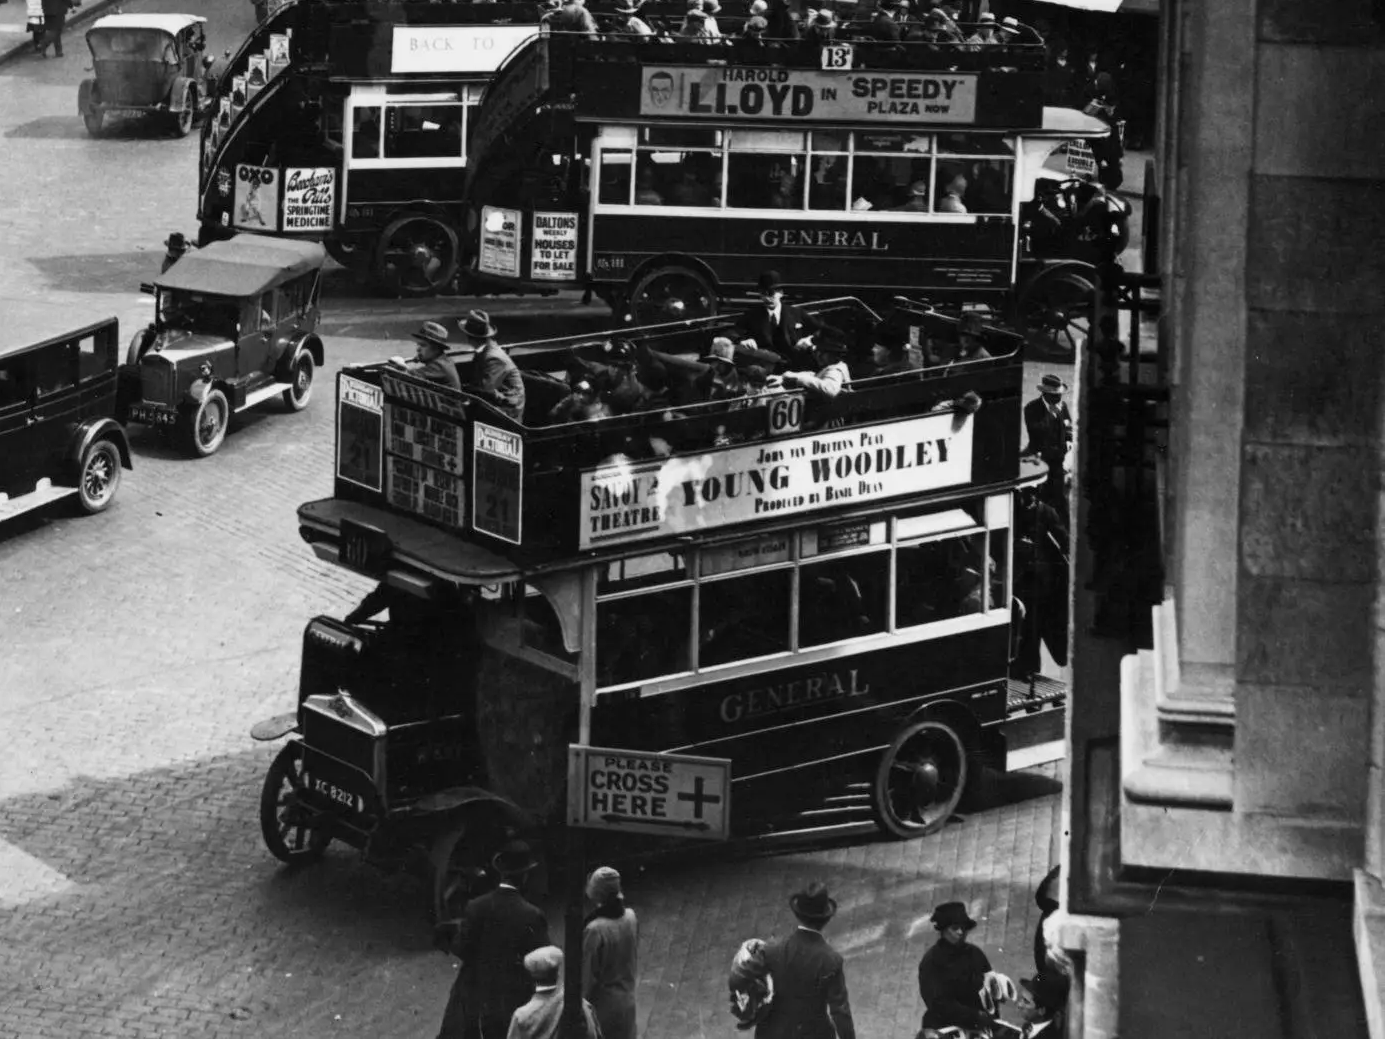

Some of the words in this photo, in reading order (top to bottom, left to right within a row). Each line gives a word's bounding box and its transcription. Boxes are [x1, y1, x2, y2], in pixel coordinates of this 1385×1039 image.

[409, 37, 455, 51] BACK
[472, 37, 495, 50] TO
[723, 68, 790, 83] HAROLD
[689, 82, 814, 117] LLOYD
[821, 87, 837, 100] IN
[868, 101, 921, 114] PLAZA
[924, 104, 950, 114] NOW
[238, 165, 274, 185] OXO
[301, 186, 332, 204] Pills
[286, 205, 331, 216] SPRINGTIME
[286, 216, 331, 227] MEDICINE
[535, 216, 576, 229] DALTONS
[534, 239, 575, 250] HOUSES
[760, 229, 889, 251] GENERAL
[540, 250, 552, 259] TO
[553, 250, 569, 259] LET
[533, 261, 550, 271] FOR
[552, 261, 574, 271] SALE
[772, 397, 802, 431] 60
[681, 465, 790, 508] YOUNG
[810, 437, 954, 483] WOODLEY
[590, 506, 660, 533] THEATRE
[720, 668, 871, 722] GENERAL
[605, 757, 673, 774] PLEASE
[590, 770, 670, 795] CROSS
[591, 792, 667, 818] HERE
